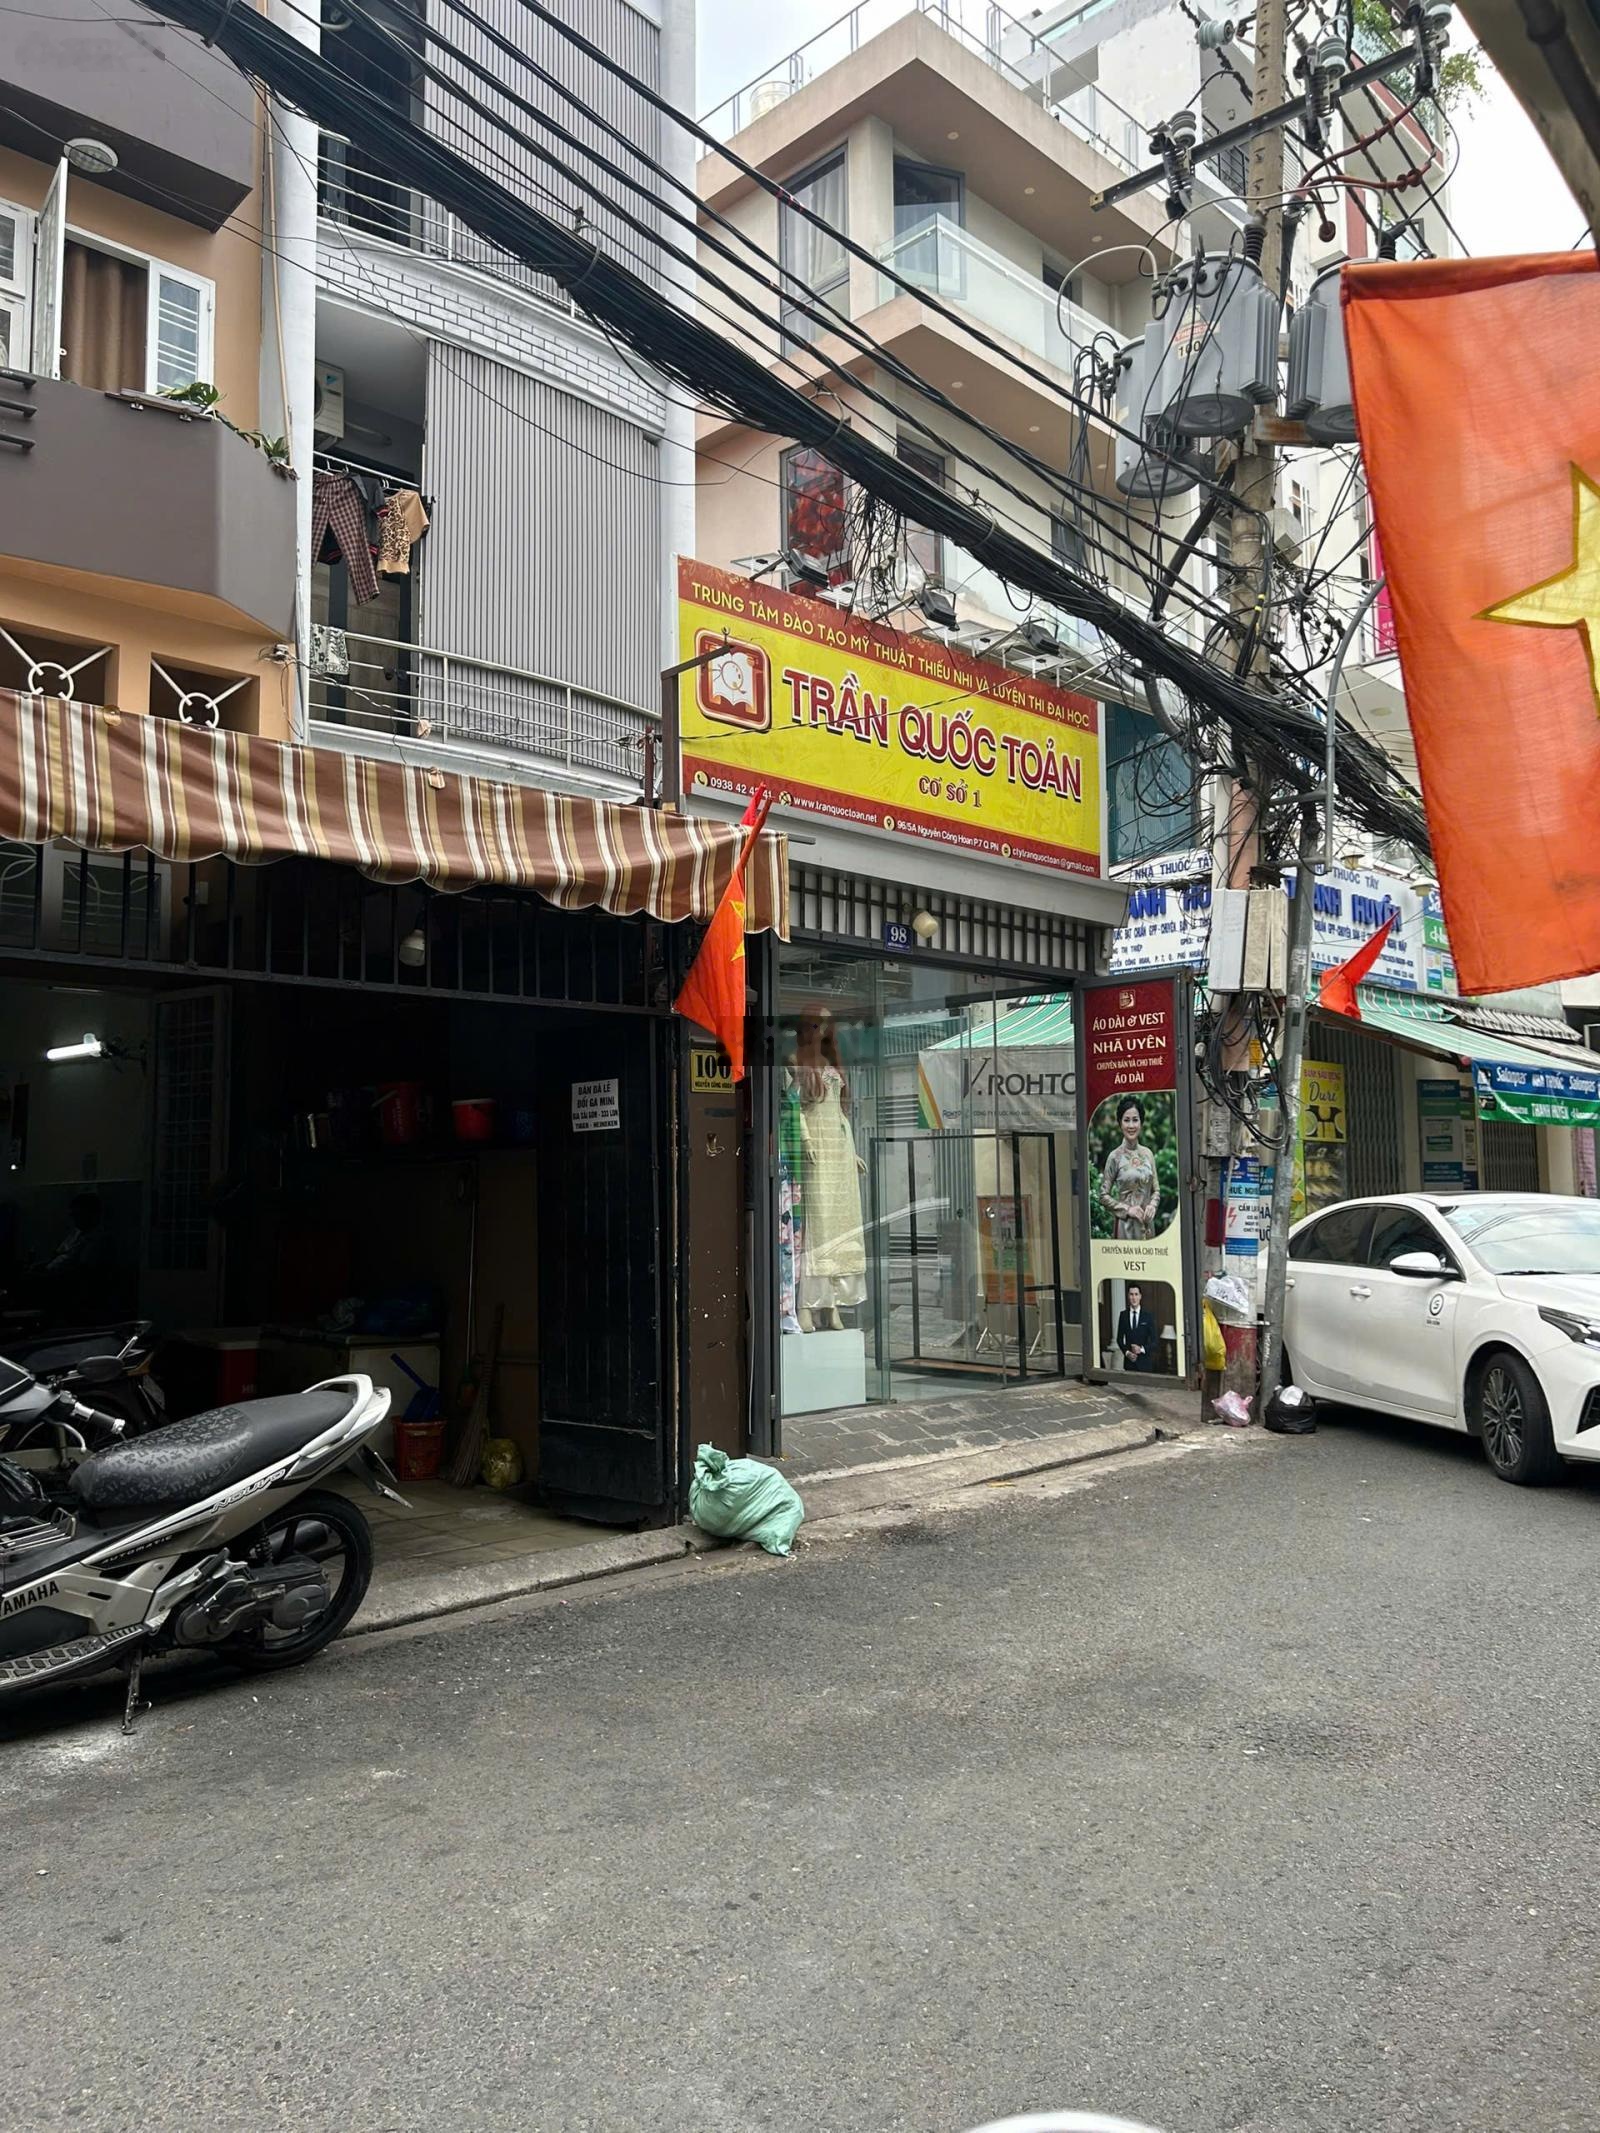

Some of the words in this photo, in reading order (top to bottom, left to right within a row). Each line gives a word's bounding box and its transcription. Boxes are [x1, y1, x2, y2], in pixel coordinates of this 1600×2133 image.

[691, 582, 745, 613] TRUNG
[749, 600, 779, 625] TÂM
[783, 610, 814, 635] ĐÀO
[818, 623, 847, 647] TẠO
[850, 632, 870, 654] MỸ
[874, 643, 915, 670] THUẬT
[918, 655, 951, 681] THIẾU
[953, 671, 973, 688] NHI
[975, 675, 991, 695] VÀ
[992, 684, 1026, 708] LUYỆN
[1028, 694, 1045, 713] THI
[1047, 702, 1065, 722] ĐẠI
[1067, 706, 1090, 729] HỌC
[783, 667, 889, 748] TRẦN
[898, 708, 997, 775] QUỐC
[1001, 737, 1082, 802] TOẢN
[710, 777, 733, 791] 0938
[736, 783, 747, 794] 42
[749, 786, 759, 796] 4
[793, 796, 877, 825] www.tranquoctoan.net
[919, 775, 943, 797] CƠ
[972, 790, 982, 808] 1
[1135, 864, 1154, 880] NHÀ
[890, 926, 907, 943] 98
[1092, 1017, 1107, 1032] ÁO
[1108, 1014, 1125, 1030] DÀI
[1139, 1012, 1165, 1026] VEST
[1093, 1038, 1123, 1054] NHÃ
[1126, 1034, 1166, 1051] UYÊN
[695, 1055, 732, 1079] 100
[1136, 1058, 1148, 1067] CHO
[1114, 1072, 1127, 1084] ÁO
[1128, 1070, 1144, 1083] DÀI
[1142, 1247, 1153, 1255] CHO
[1123, 1260, 1146, 1271] VEST
[0, 1580, 60, 1617] AMAHA
